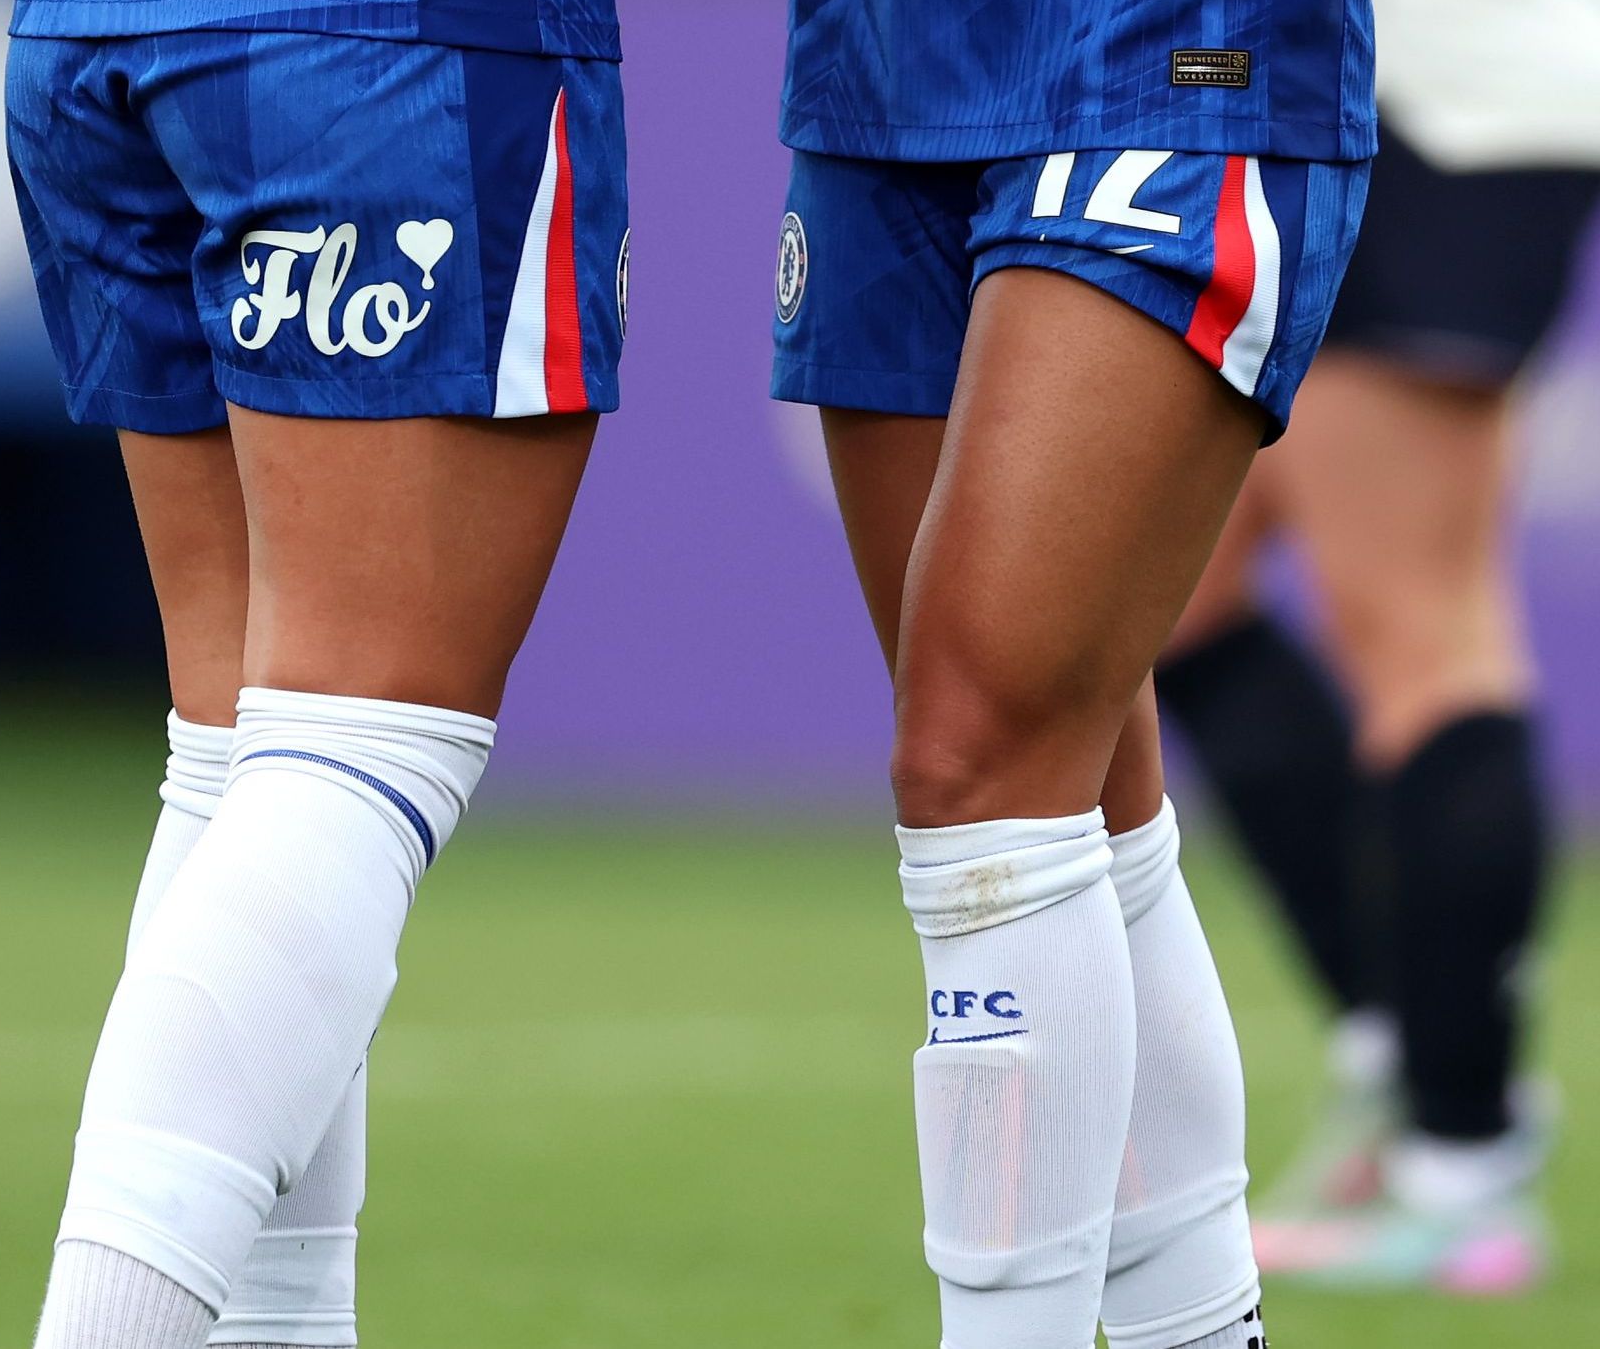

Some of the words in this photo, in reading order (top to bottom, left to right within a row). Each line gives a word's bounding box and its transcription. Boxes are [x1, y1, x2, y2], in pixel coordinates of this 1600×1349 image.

[1031, 150, 1182, 235] 12
[231, 223, 430, 357] Flo
[931, 990, 1023, 1019] CFC
